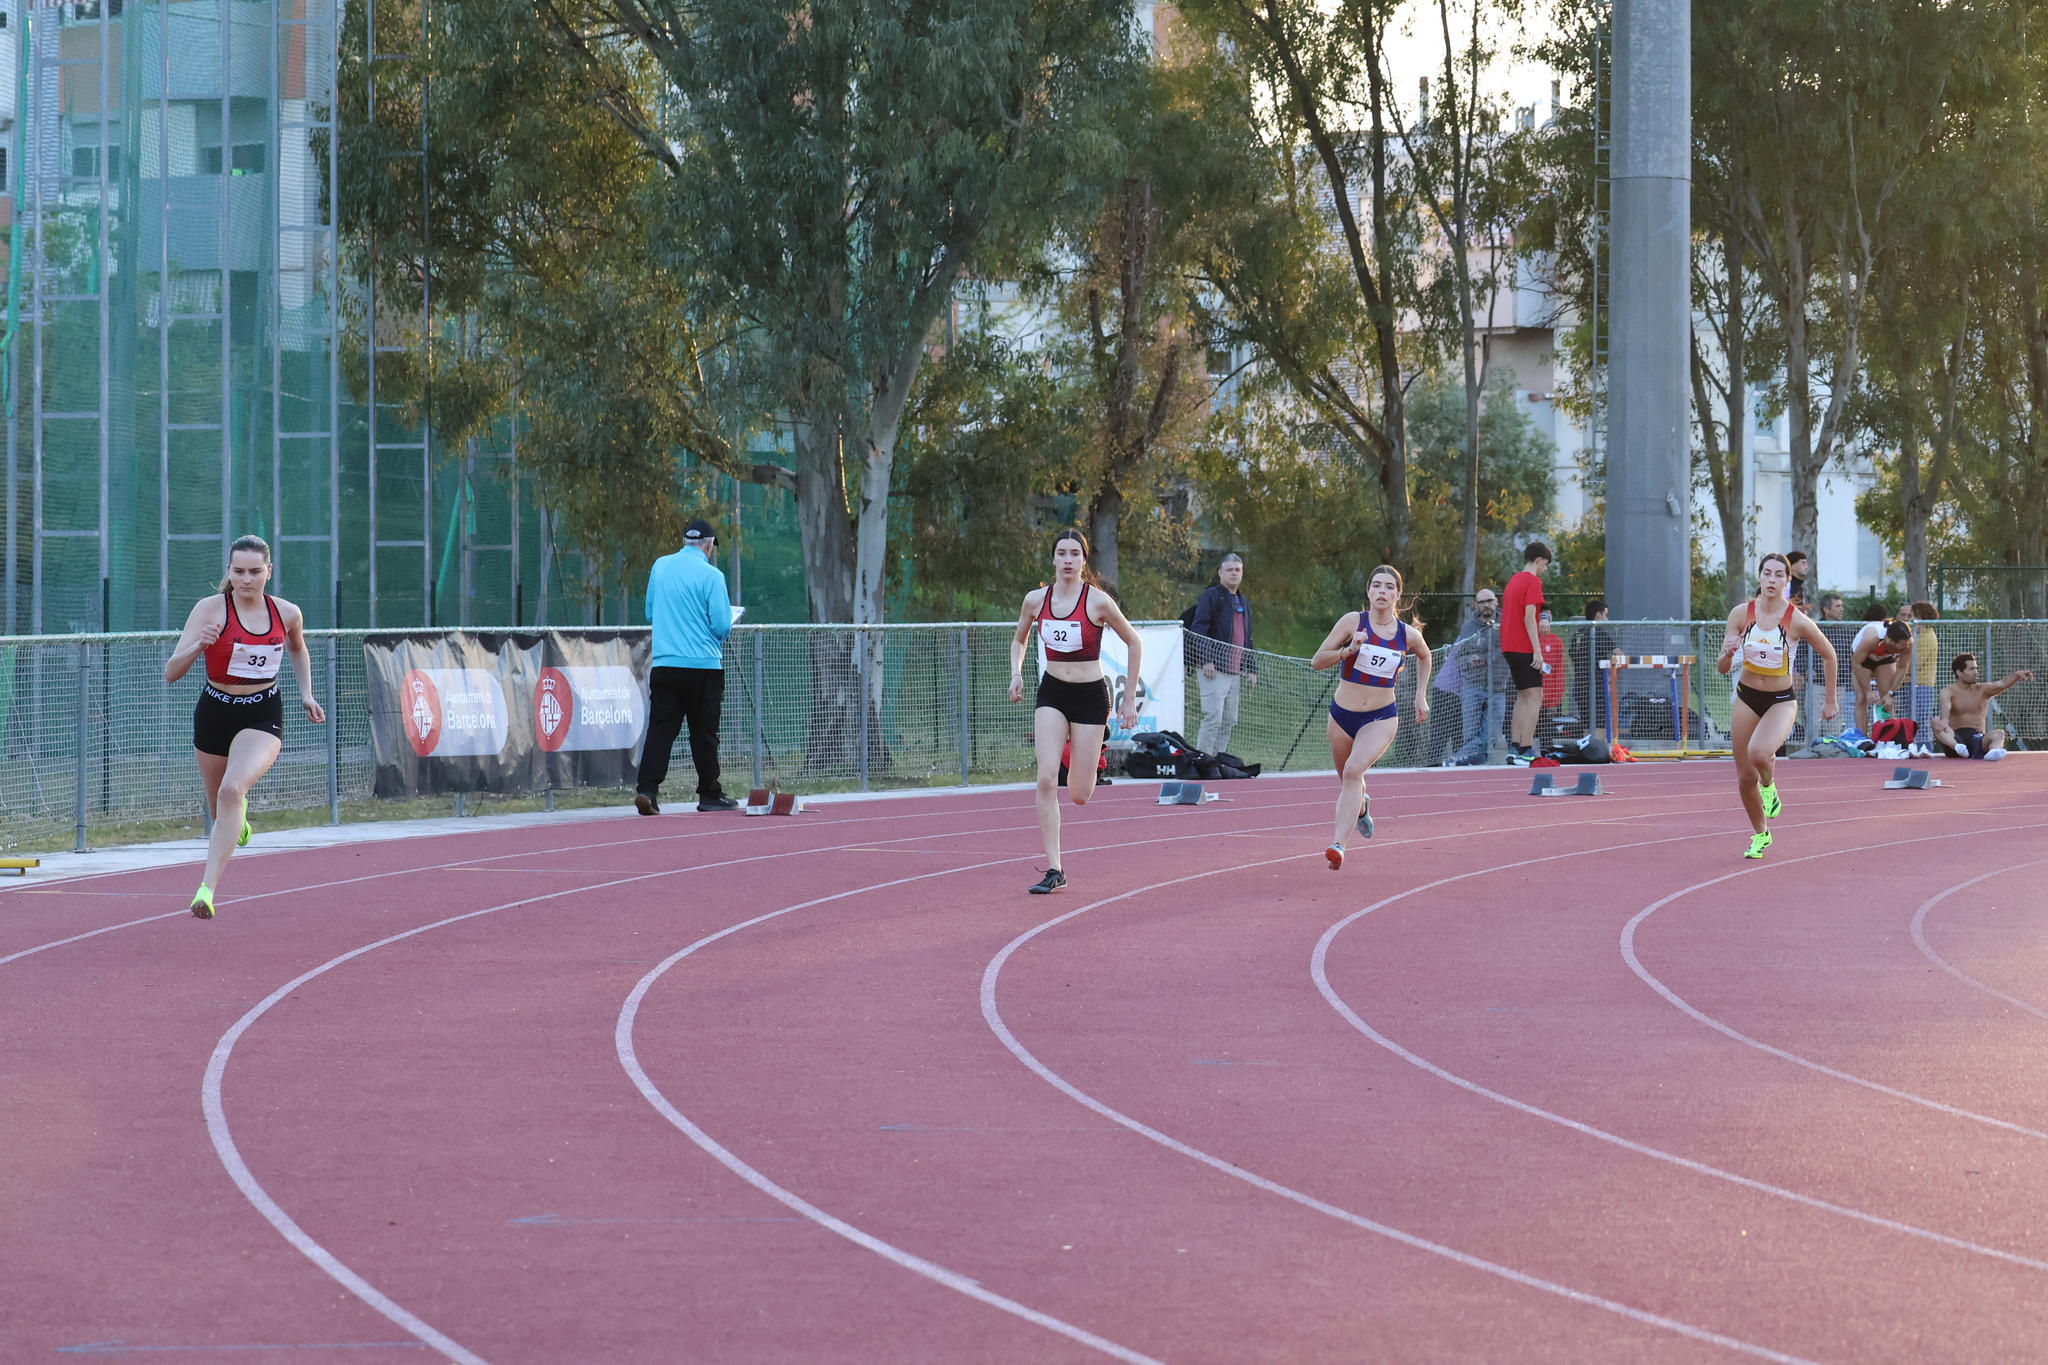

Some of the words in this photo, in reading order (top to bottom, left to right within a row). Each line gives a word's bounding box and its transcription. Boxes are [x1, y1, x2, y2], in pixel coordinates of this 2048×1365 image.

[1053, 630, 1068, 642] 32
[247, 655, 267, 667] 33
[1370, 655, 1387, 667] 57
[205, 685, 232, 704] NIKE
[232, 693, 264, 705] PRO
[581, 687, 621, 704] Ajuntament
[621, 685, 631, 700] de
[447, 710, 496, 729] Barcelona
[581, 704, 633, 725] Barcelona
[1156, 764, 1176, 776] HH
